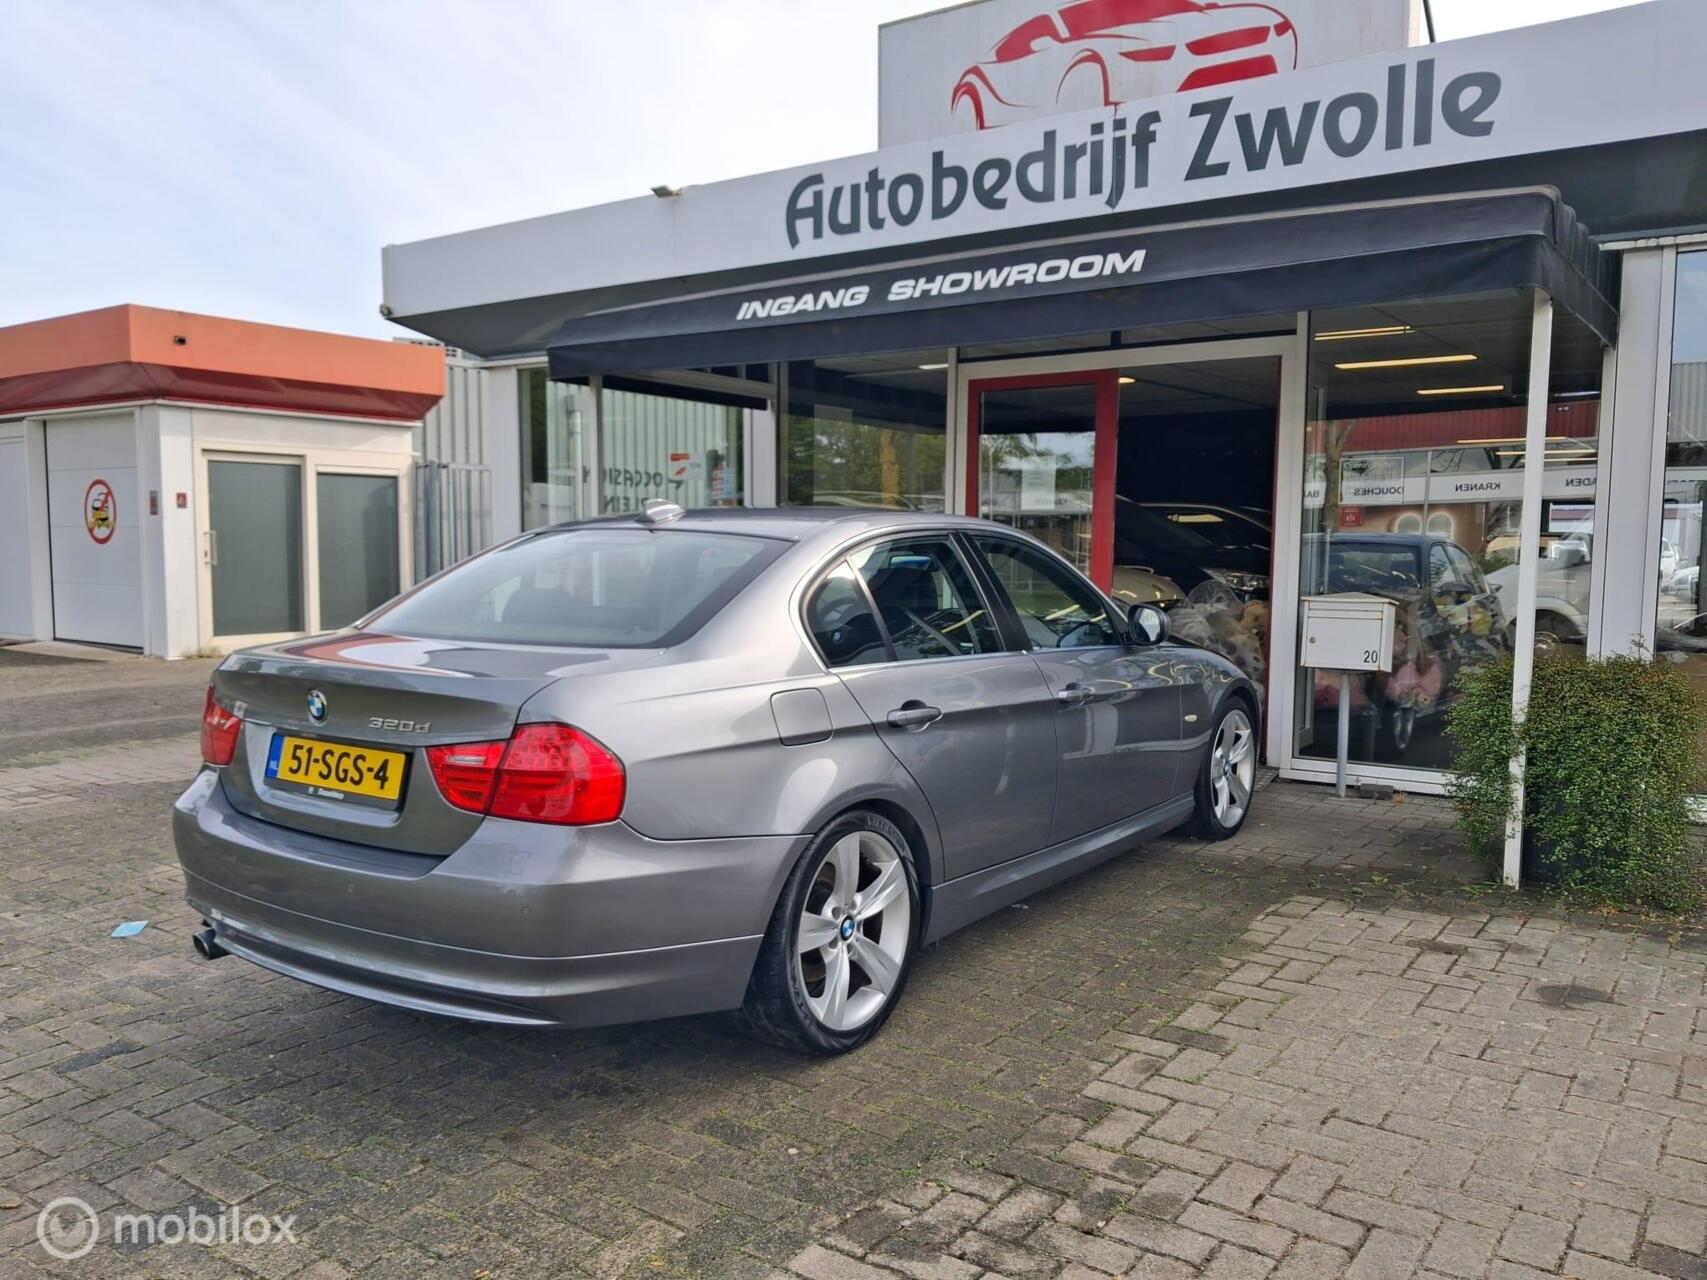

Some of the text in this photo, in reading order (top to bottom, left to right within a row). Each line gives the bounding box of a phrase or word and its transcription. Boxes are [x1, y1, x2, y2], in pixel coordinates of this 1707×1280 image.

[785, 58, 1502, 249] Autobedrijf Zwolle
[735, 248, 1147, 321] INGANG SHOWROOM
[1363, 649, 1378, 664] 20
[368, 716, 432, 734] 320d
[288, 744, 390, 790] 51-SGS-4
